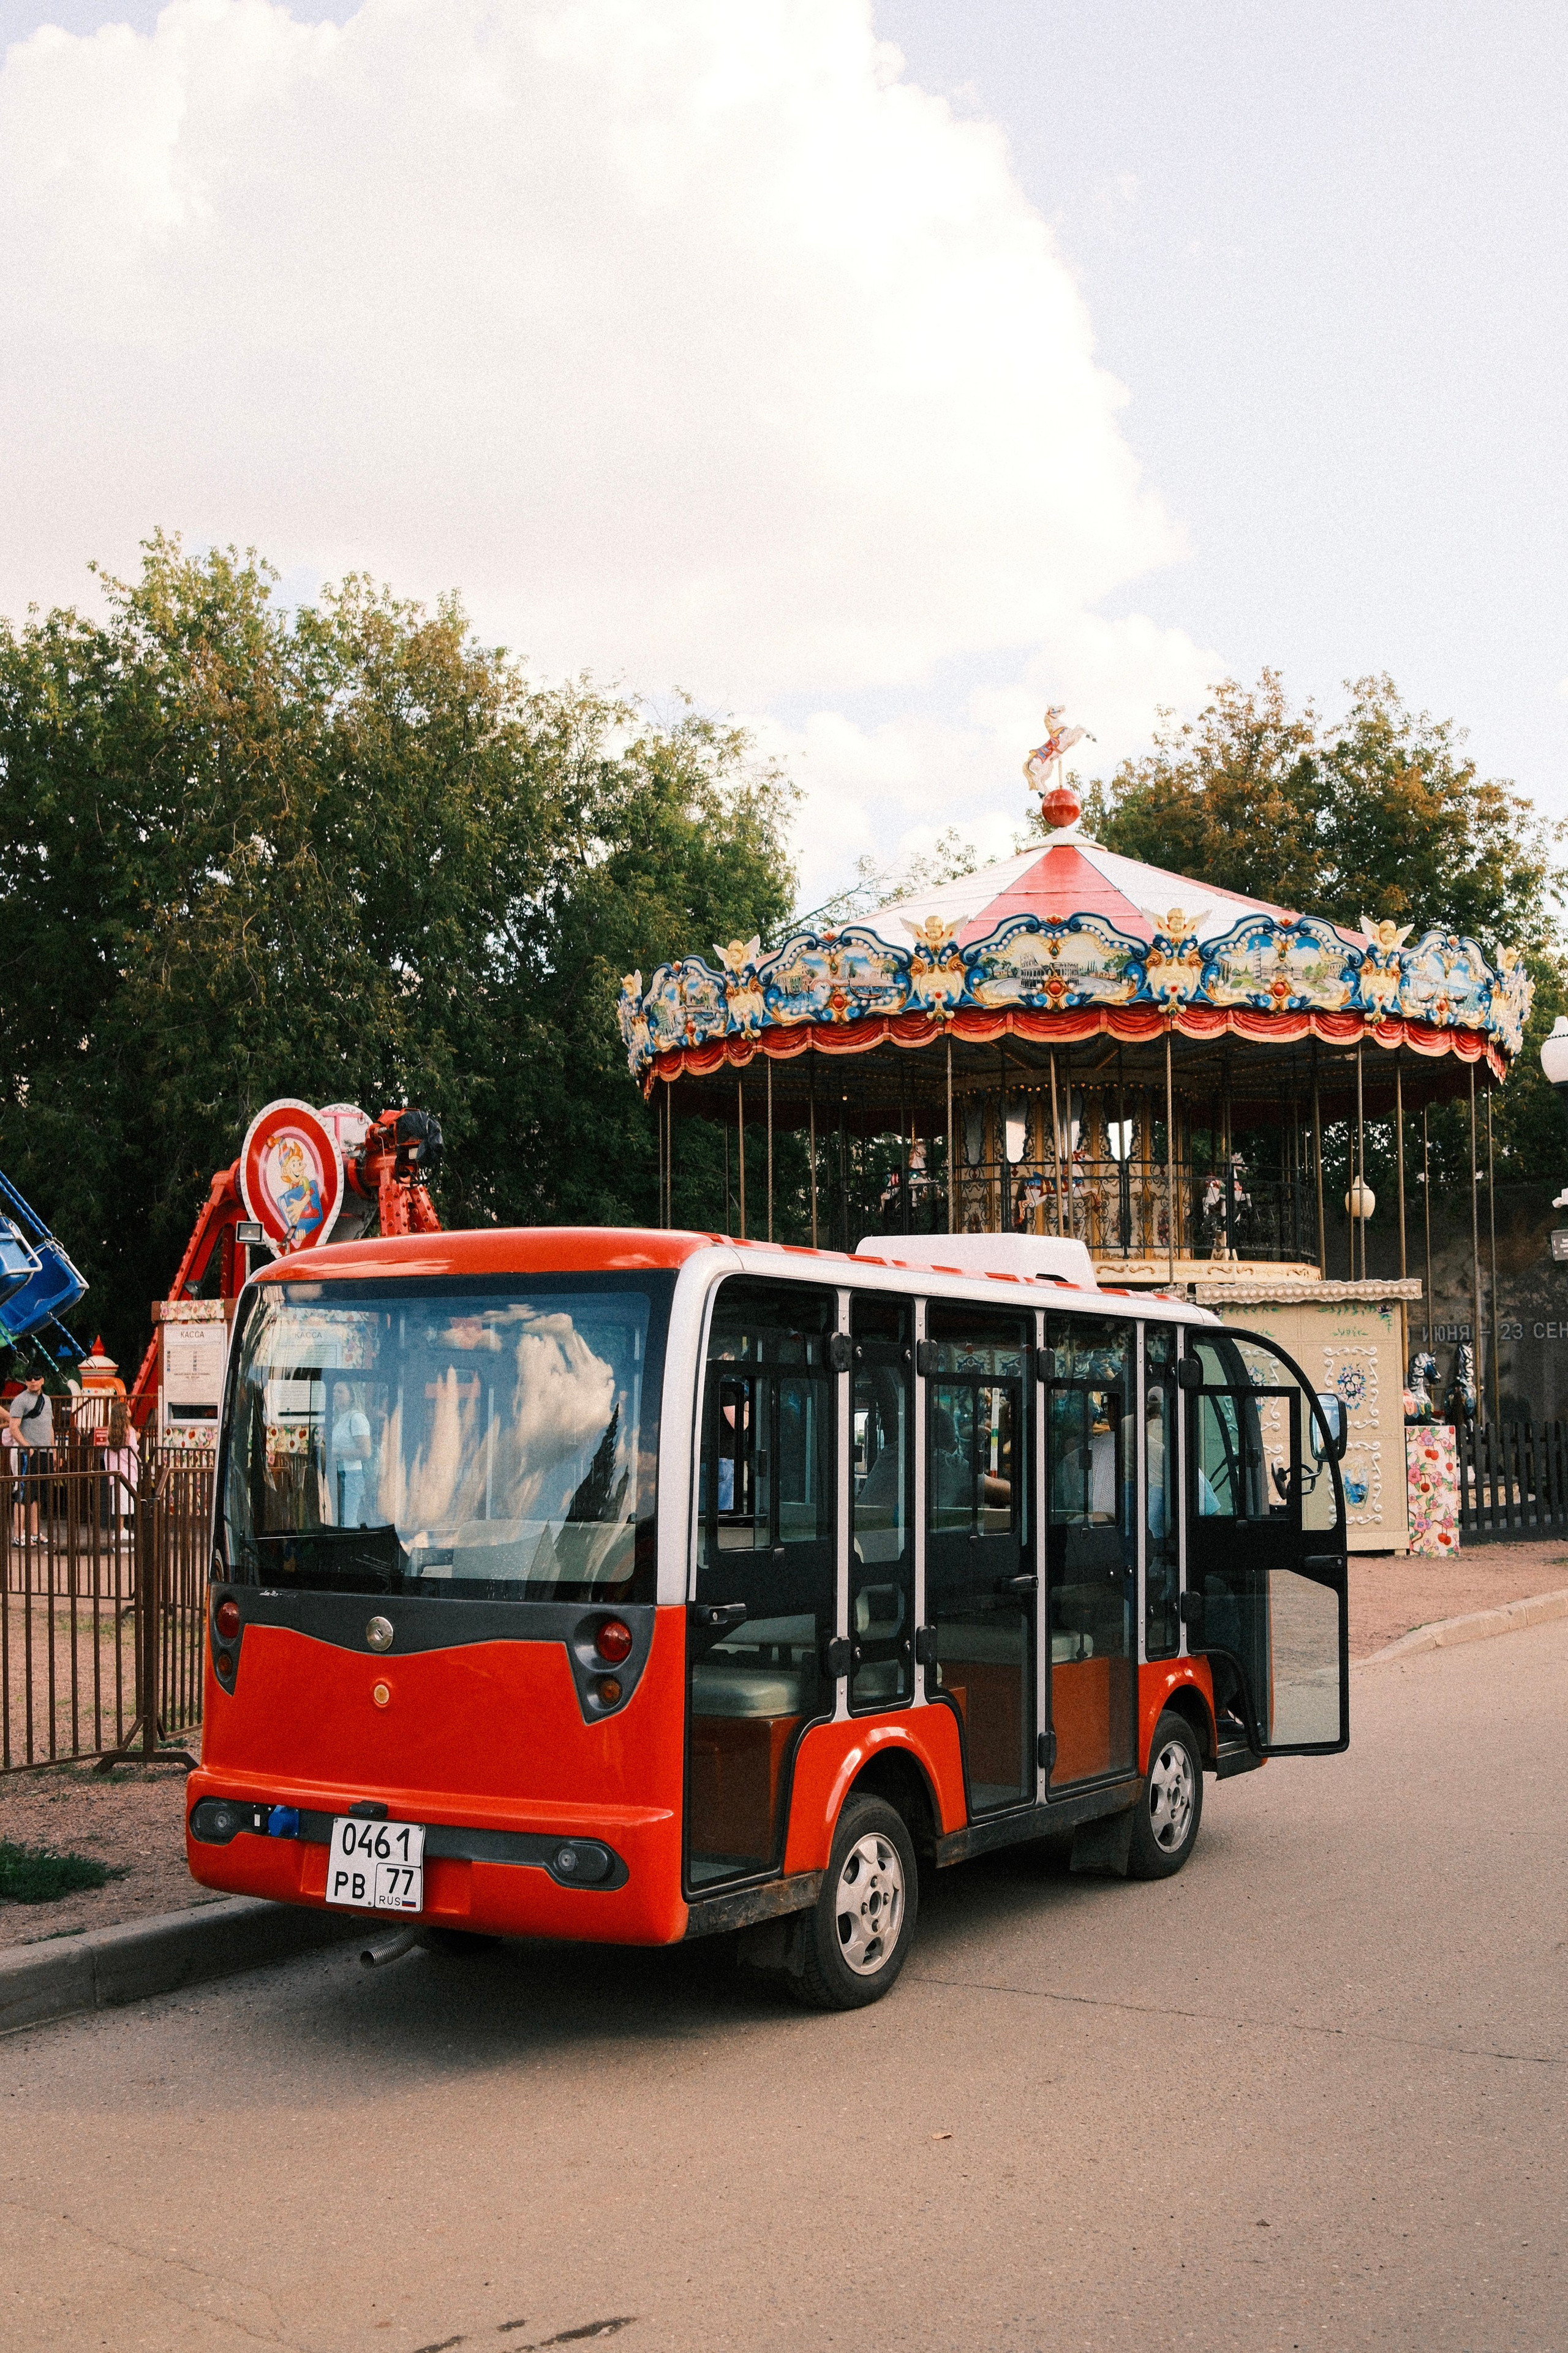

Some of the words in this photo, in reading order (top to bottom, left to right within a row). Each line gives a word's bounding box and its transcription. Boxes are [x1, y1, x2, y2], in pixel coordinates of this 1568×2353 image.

[1500, 1322, 1523, 1340] 23
[342, 1822, 410, 1862] 0461
[386, 1868, 414, 1895] 77
[379, 1895, 401, 1906] RUS
